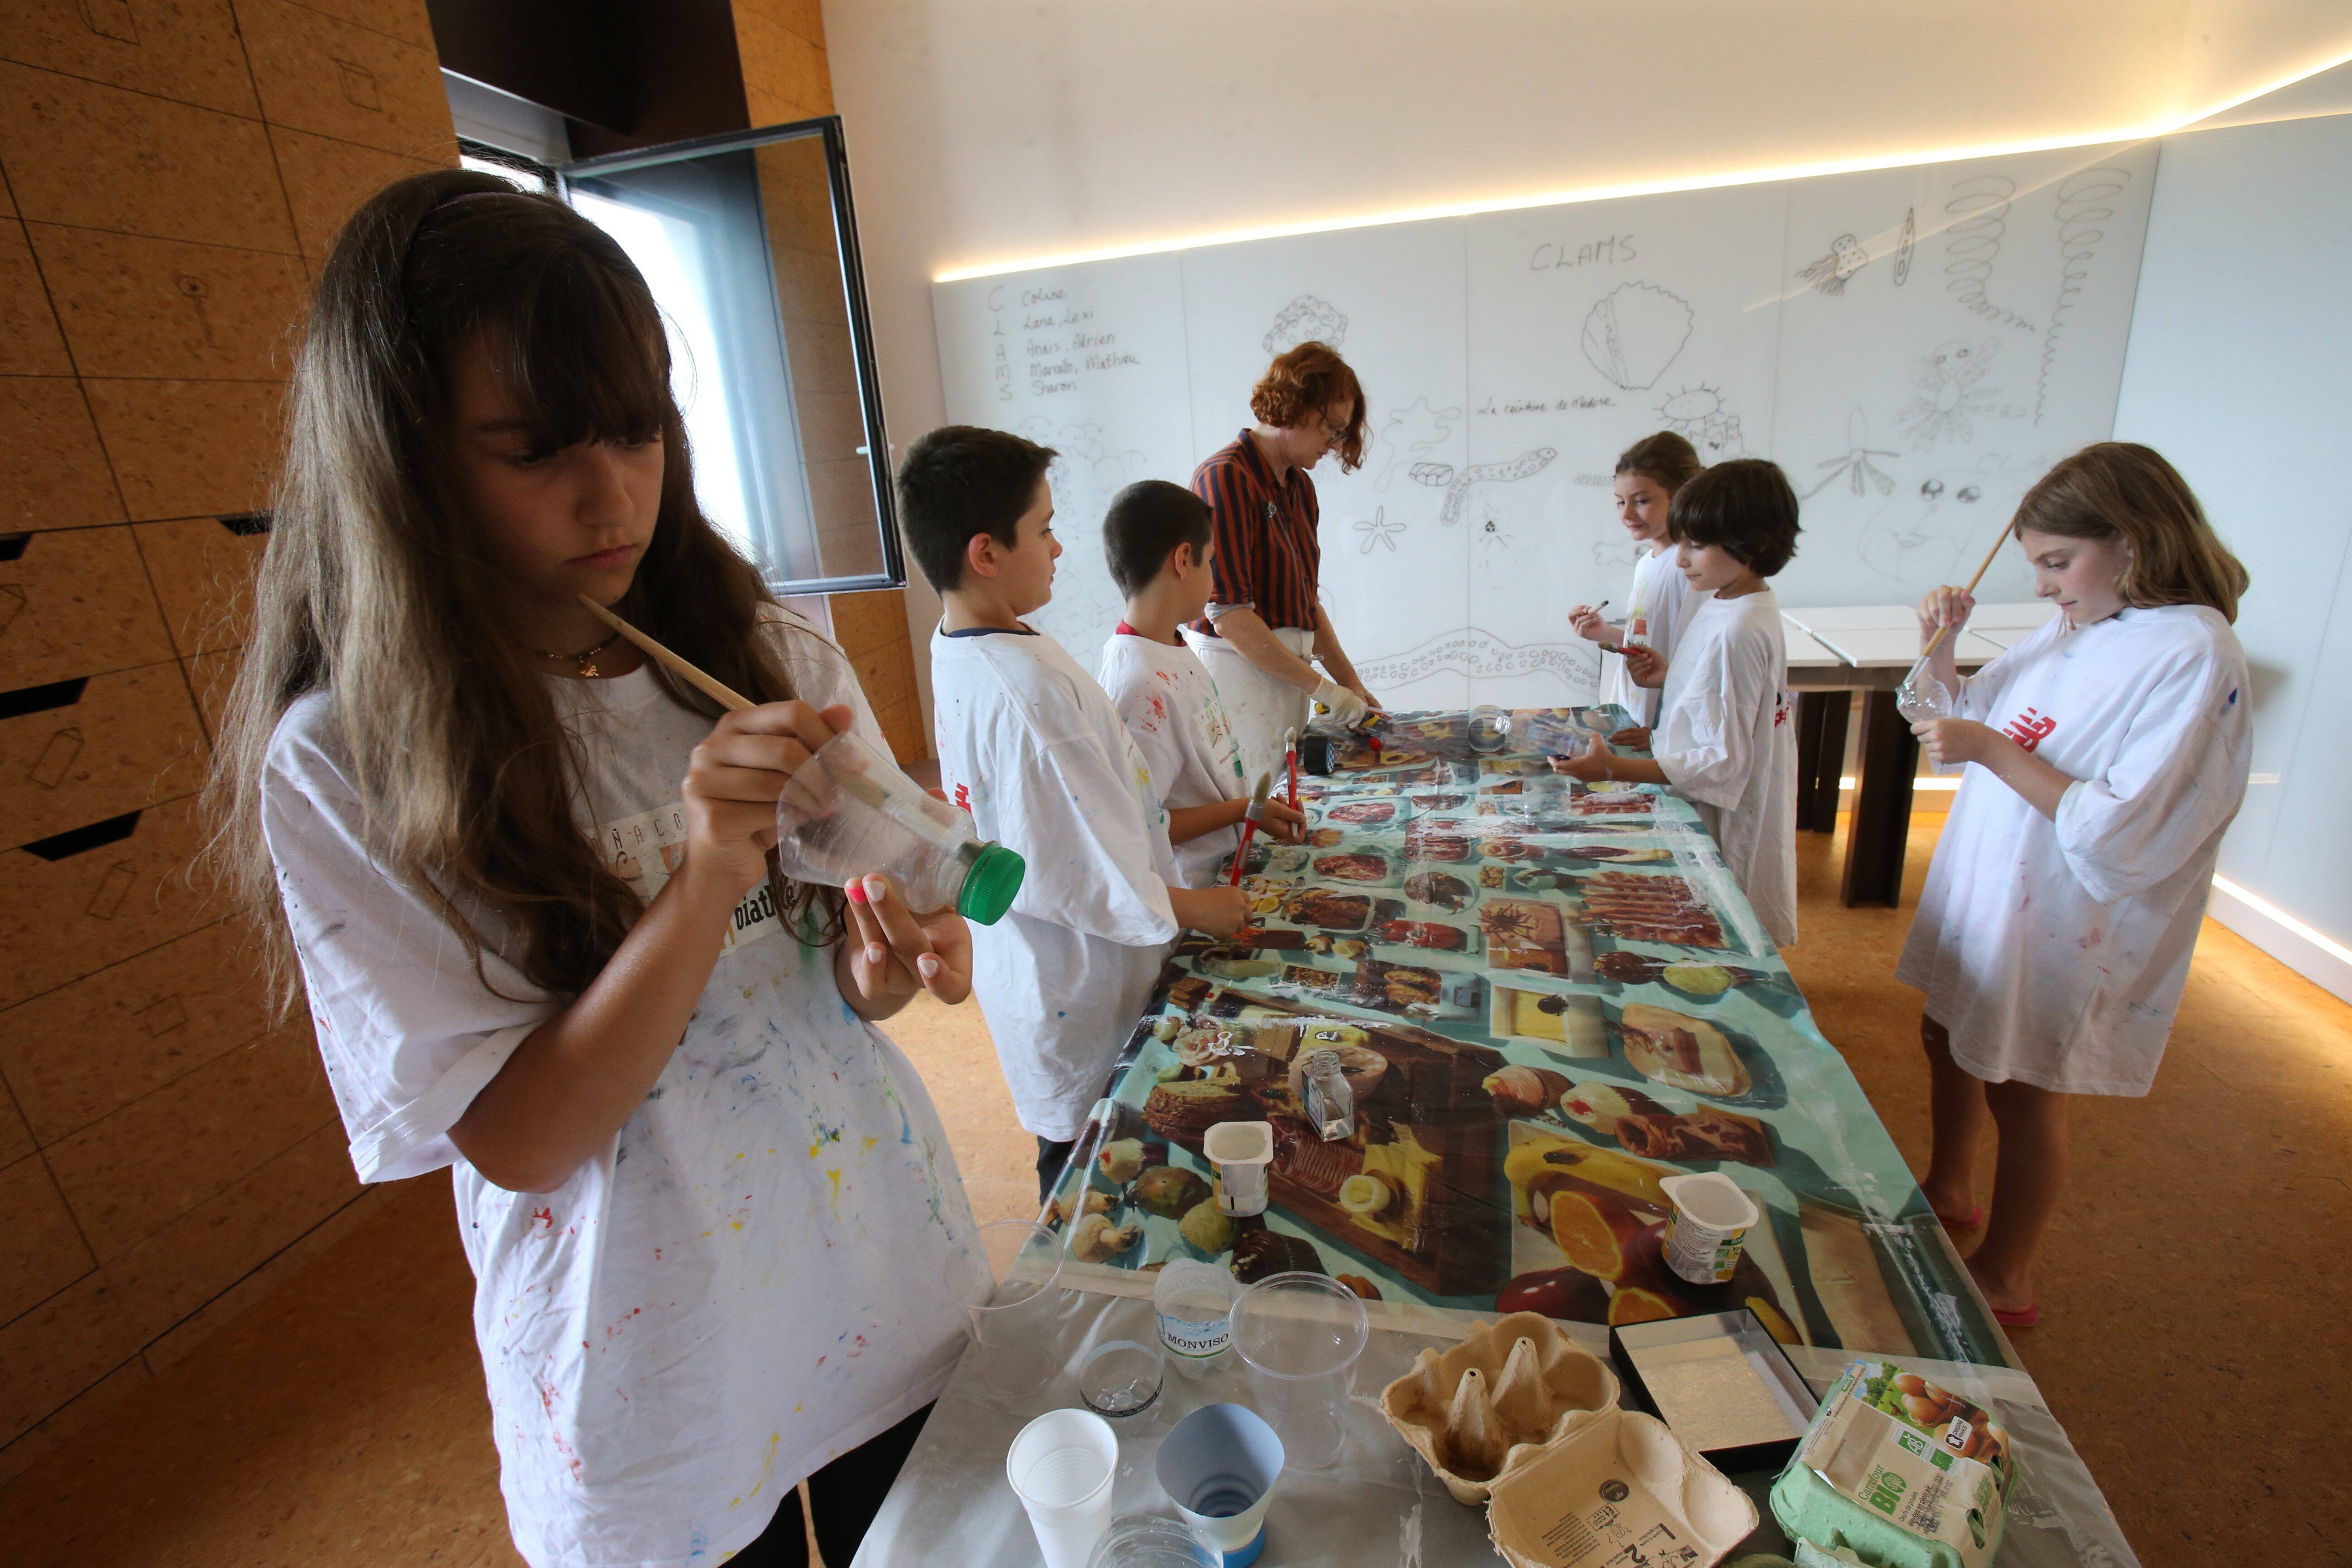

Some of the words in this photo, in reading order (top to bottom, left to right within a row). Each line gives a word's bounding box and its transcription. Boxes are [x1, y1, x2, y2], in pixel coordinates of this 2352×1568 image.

[1530, 235, 1636, 271] CLAMS
[988, 286, 1004, 312] C
[1022, 288, 1066, 306] Coline
[994, 319, 1004, 336] L
[996, 343, 1006, 361] A
[996, 364, 1010, 381] M
[1086, 352, 1140, 370] Mathieu
[1000, 384, 1013, 401] S
[1032, 380, 1077, 396] Sharon
[1167, 1333, 1229, 1349] MONVISO
[1952, 1419, 1963, 1435] ORIGINE
[1958, 1425, 1968, 1438] FRANCE
[1906, 1437, 1924, 1455] AB
[1858, 1464, 1884, 1500] Carrefour
[1869, 1472, 1906, 1515] BIO
[1908, 1491, 1918, 1506] poules
[1906, 1508, 1921, 1527] élevées
[1919, 1491, 1929, 1505] plein
